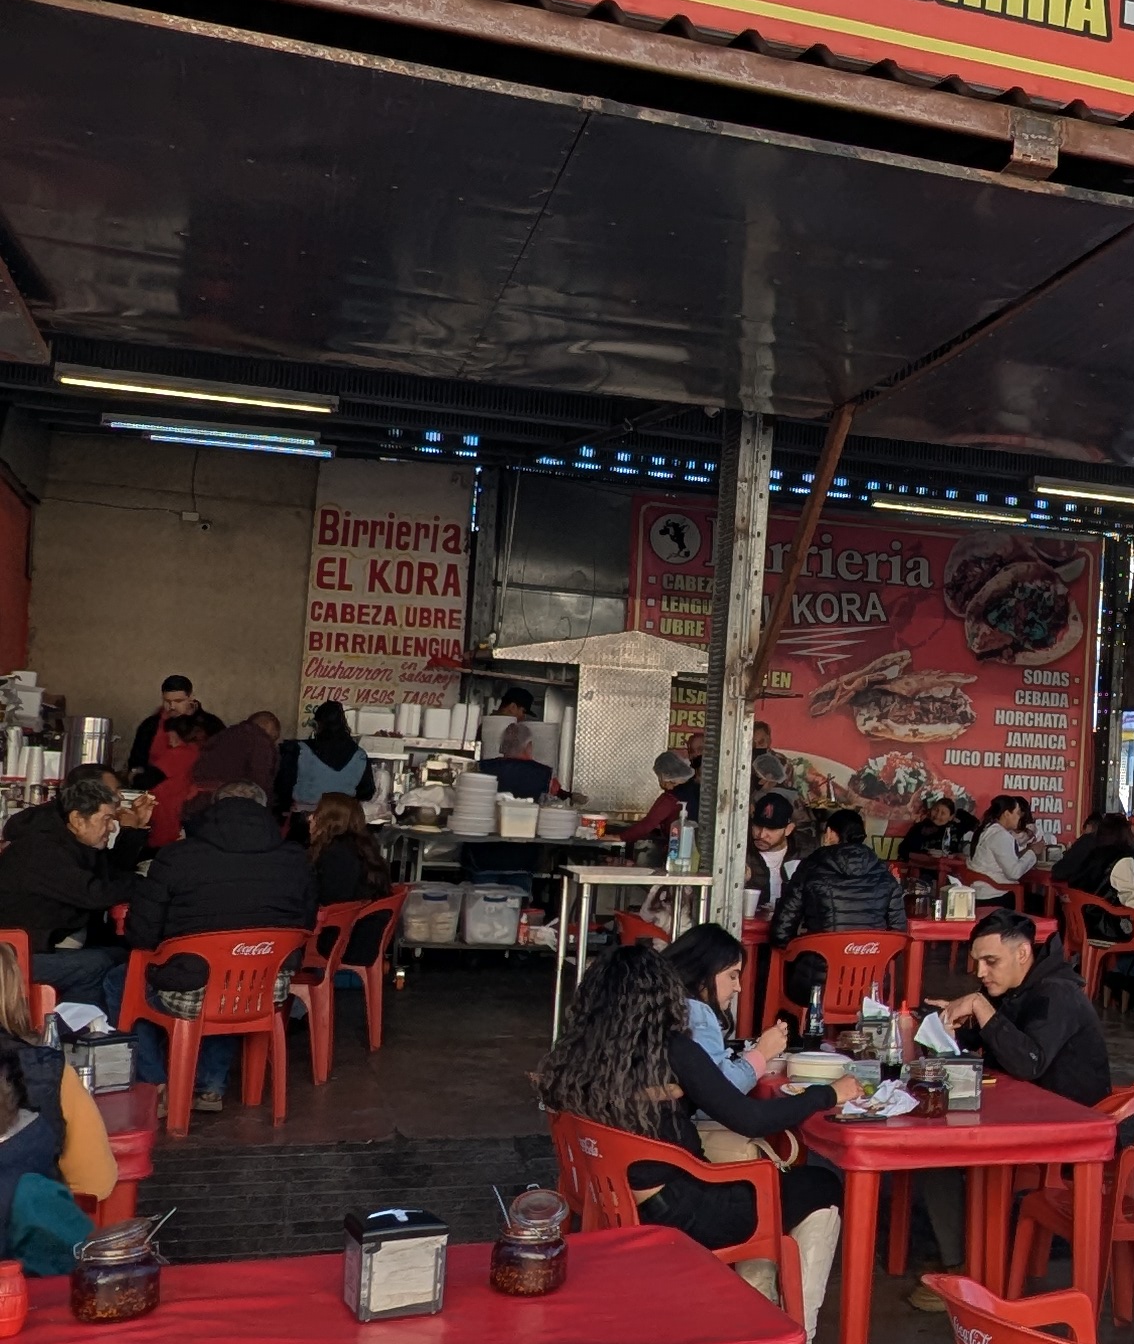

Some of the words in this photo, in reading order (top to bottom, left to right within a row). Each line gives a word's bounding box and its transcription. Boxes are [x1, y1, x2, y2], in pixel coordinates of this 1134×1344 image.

[318, 509, 462, 555] Birrieria
[316, 556, 352, 591] EL
[368, 559, 461, 598] KORA
[662, 573, 714, 593] CABEZ
[661, 595, 713, 615] LENGU
[793, 592, 887, 624] KORA
[405, 606, 462, 630] UBRE
[660, 617, 705, 637] UBRE
[391, 636, 463, 658] LENGUA
[771, 671, 791, 688] EN
[1023, 669, 1070, 687] SODAS
[303, 685, 350, 702] PLATOS
[355, 689, 395, 705] VASOS
[402, 690, 445, 706] TACOS
[1015, 690, 1069, 708] CEBADA
[995, 710, 1068, 729] HORCHATA
[1006, 732, 1067, 750] JAMAICA
[944, 749, 981, 767] JUGO
[983, 751, 1002, 768] DE
[1004, 753, 1066, 771] NARANJA
[1003, 774, 1064, 792] NATURAL
[1030, 794, 1063, 813] PIÑA
